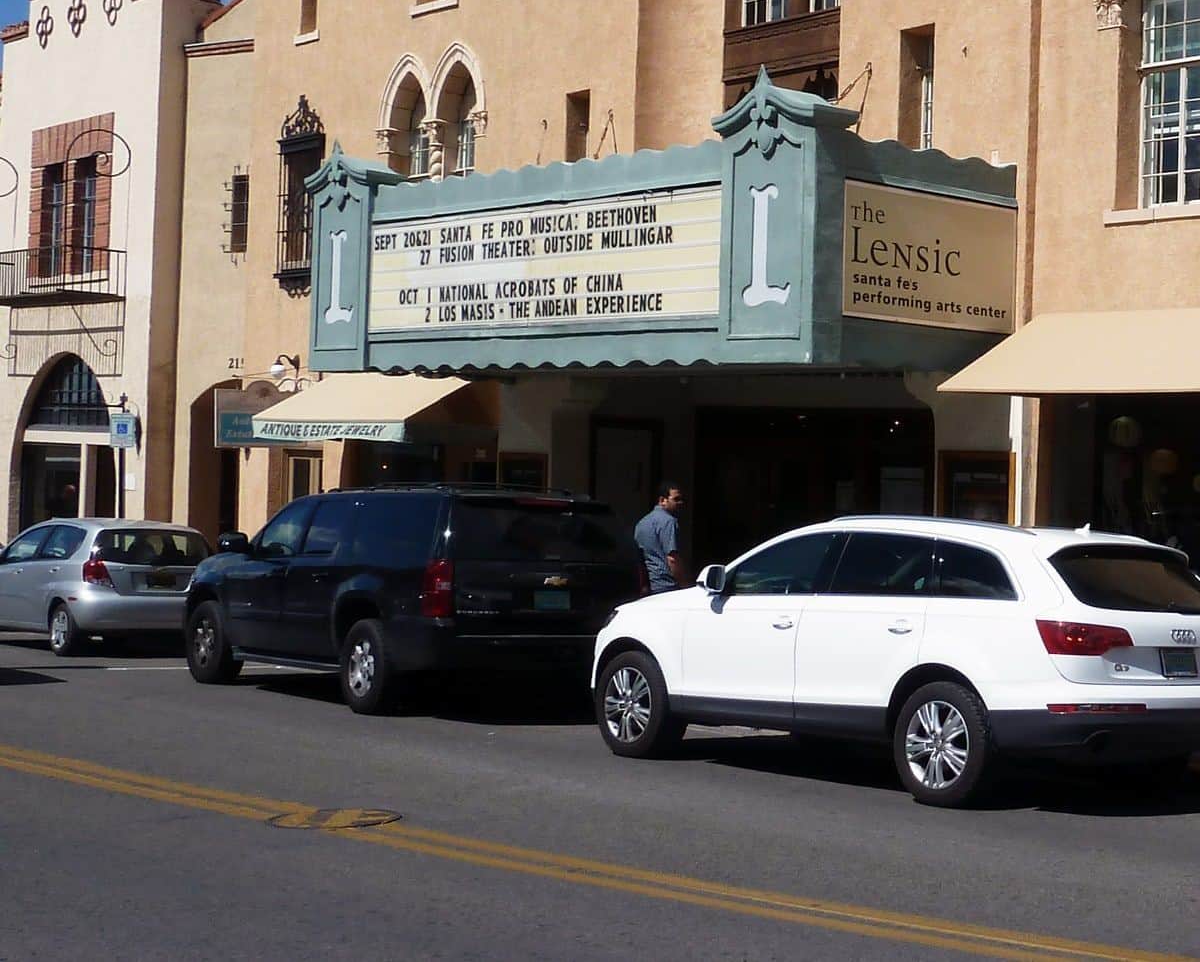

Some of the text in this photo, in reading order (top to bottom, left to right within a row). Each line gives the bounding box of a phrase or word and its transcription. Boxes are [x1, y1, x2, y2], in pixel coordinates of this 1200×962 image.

[374, 233, 397, 251] SEPT
[440, 225, 472, 244] SANTA
[481, 222, 494, 240] FE
[500, 219, 523, 237] PRO
[587, 205, 657, 229] BEETHOVEN
[420, 249, 431, 265] 27
[440, 244, 474, 264] FUSION
[544, 233, 593, 254] OUTSIDE
[601, 226, 673, 249] MULLINGAR
[400, 289, 419, 305] OCT
[440, 283, 488, 302] NATIONAL
[495, 278, 555, 298] ACROBATS
[563, 277, 578, 294] OF
[586, 274, 623, 293] CHINA
[853, 272, 919, 291] santa fe's
[425, 307, 431, 323] 2
[439, 306, 456, 322] LOS
[509, 301, 530, 319] THE
[534, 298, 577, 317] ANDEAN
[586, 293, 663, 315] EXPERIENCE
[852, 291, 1007, 319] performing arts center
[261, 423, 302, 436] ANTIQUE
[309, 424, 342, 437] ESTATE
[340, 424, 386, 437] JEWELRY
